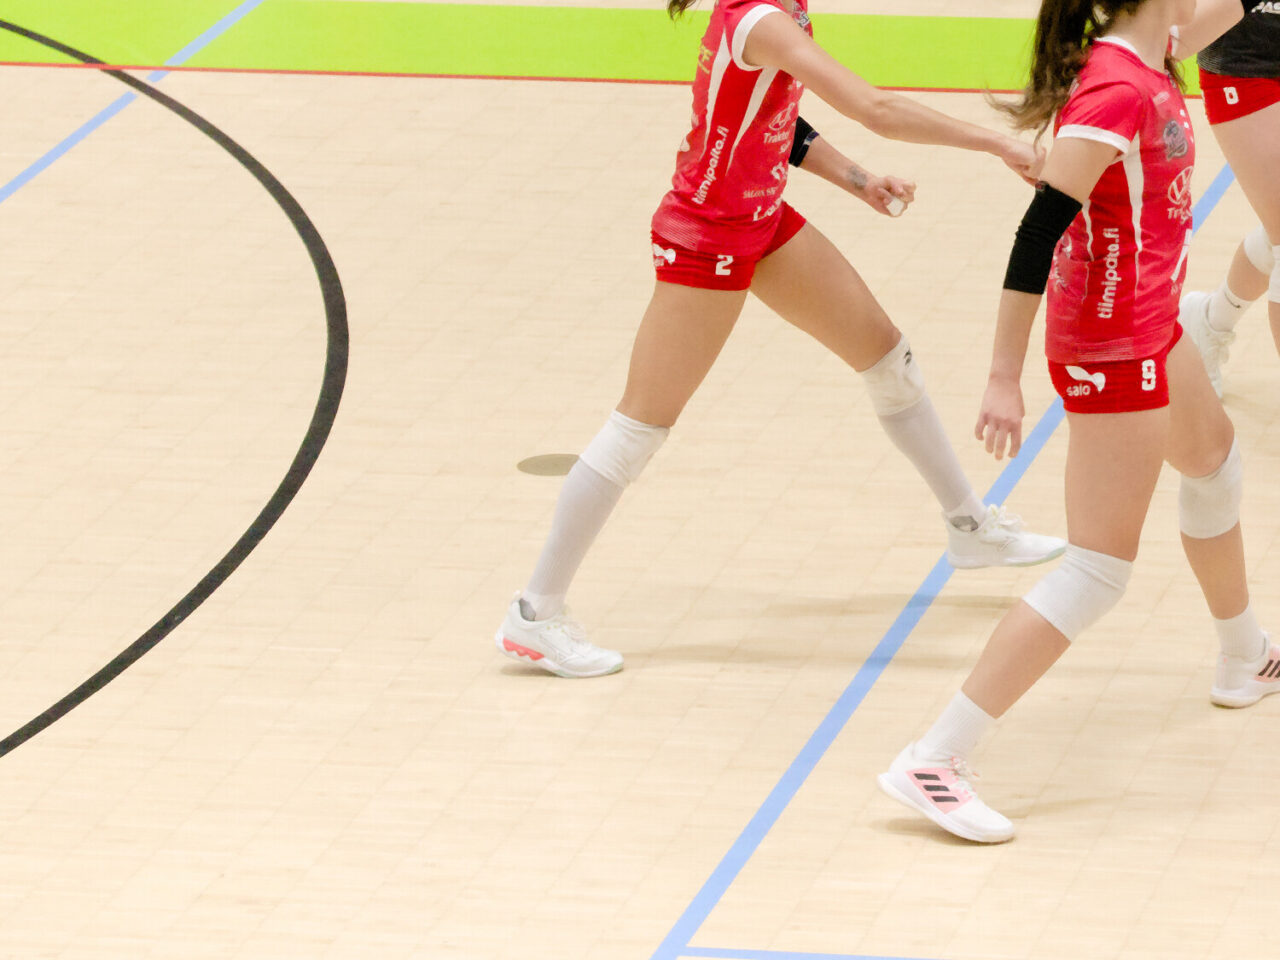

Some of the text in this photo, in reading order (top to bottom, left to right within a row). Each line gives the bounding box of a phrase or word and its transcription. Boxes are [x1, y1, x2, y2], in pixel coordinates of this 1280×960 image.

[715, 255, 734, 276] 2
[1141, 359, 1157, 391] 9
[1066, 384, 1091, 397] salo
